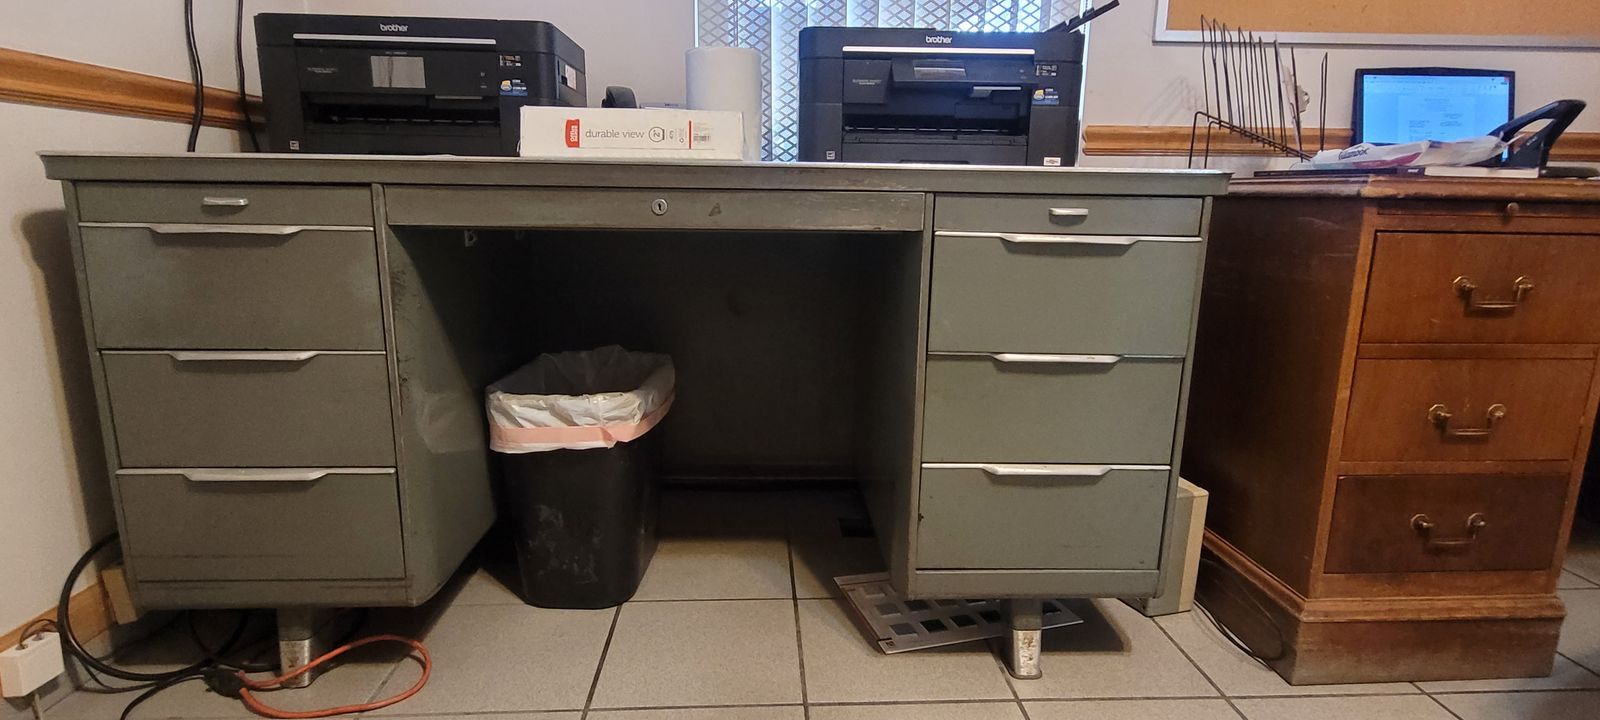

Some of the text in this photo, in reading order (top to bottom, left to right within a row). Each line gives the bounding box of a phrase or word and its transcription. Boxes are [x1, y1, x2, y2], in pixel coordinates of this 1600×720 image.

[379, 23, 409, 32] brother
[925, 35, 953, 44] brother
[585, 129, 620, 138] durable
[622, 129, 645, 138] view
